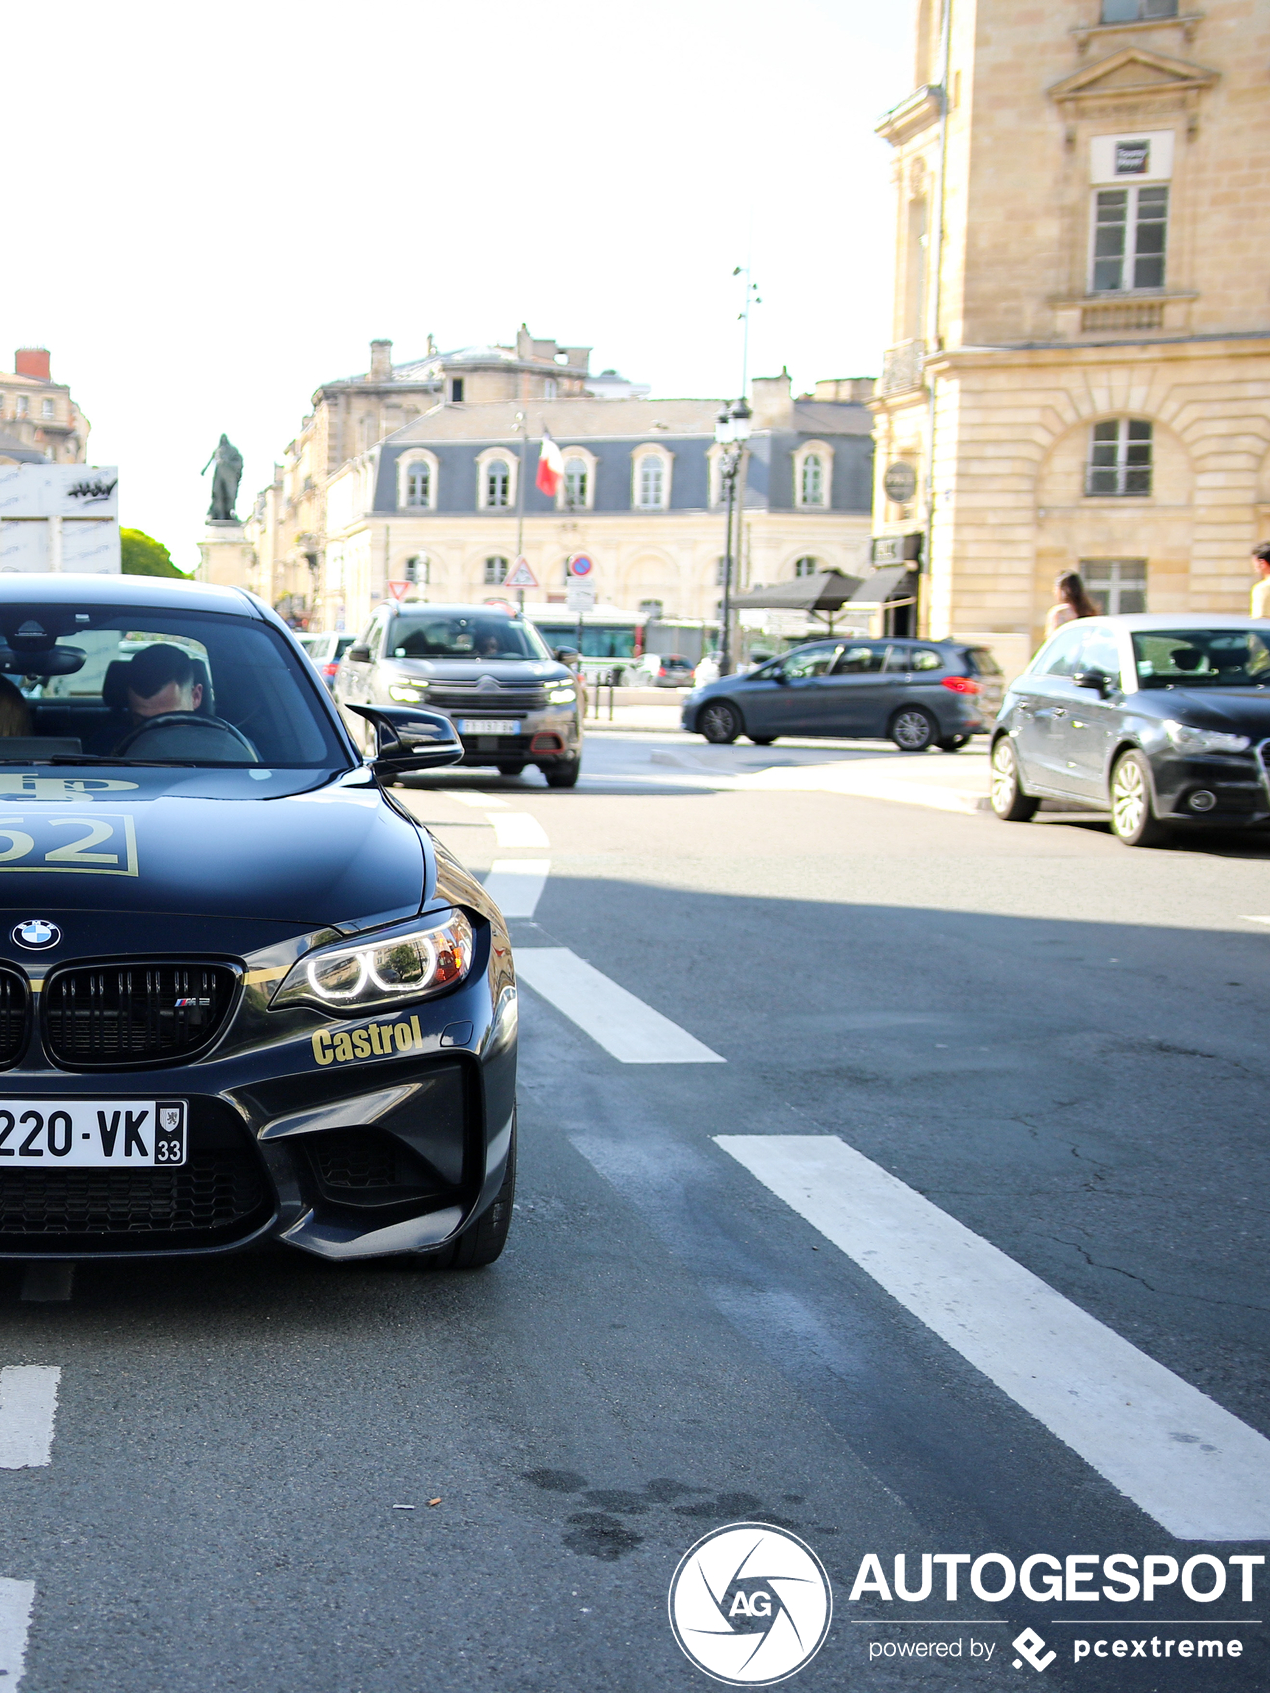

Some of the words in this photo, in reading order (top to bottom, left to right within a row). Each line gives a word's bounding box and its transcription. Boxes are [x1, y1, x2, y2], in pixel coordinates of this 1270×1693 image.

[17, 920, 57, 930] BMW
[311, 1015, 423, 1065] Castrol
[157, 1140, 181, 1162] 33
